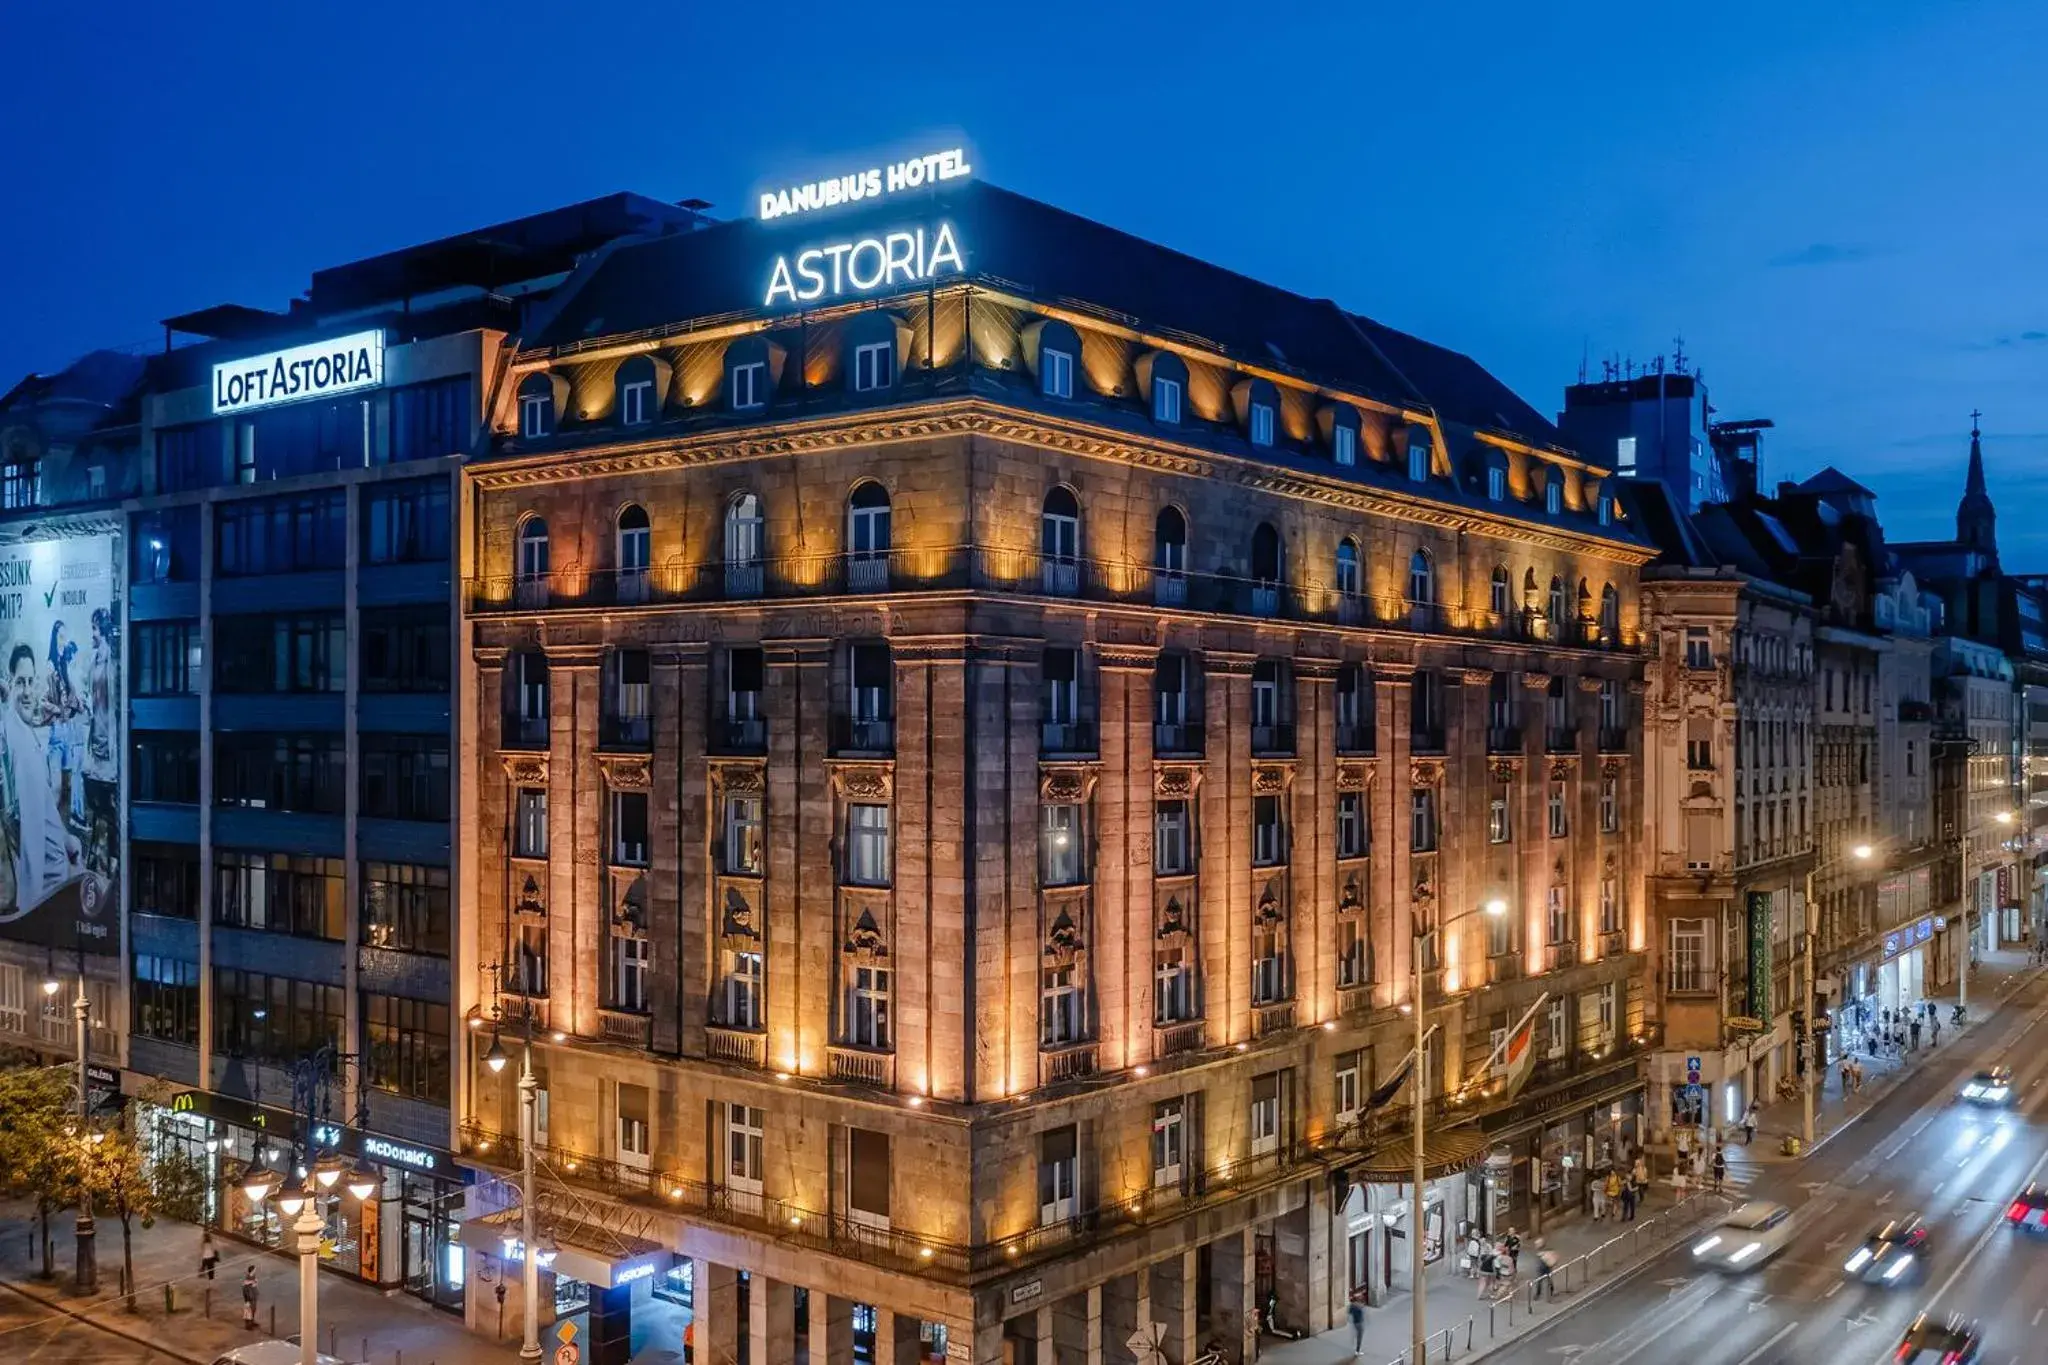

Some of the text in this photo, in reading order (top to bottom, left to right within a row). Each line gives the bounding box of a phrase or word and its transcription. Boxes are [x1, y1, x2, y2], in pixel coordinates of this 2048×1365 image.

[760, 148, 971, 220] DANUBIUS HOTEL
[764, 223, 964, 306] ASTORIA
[365, 1138, 435, 1169] McDonald's
[616, 1263, 655, 1285] ASTORIA
